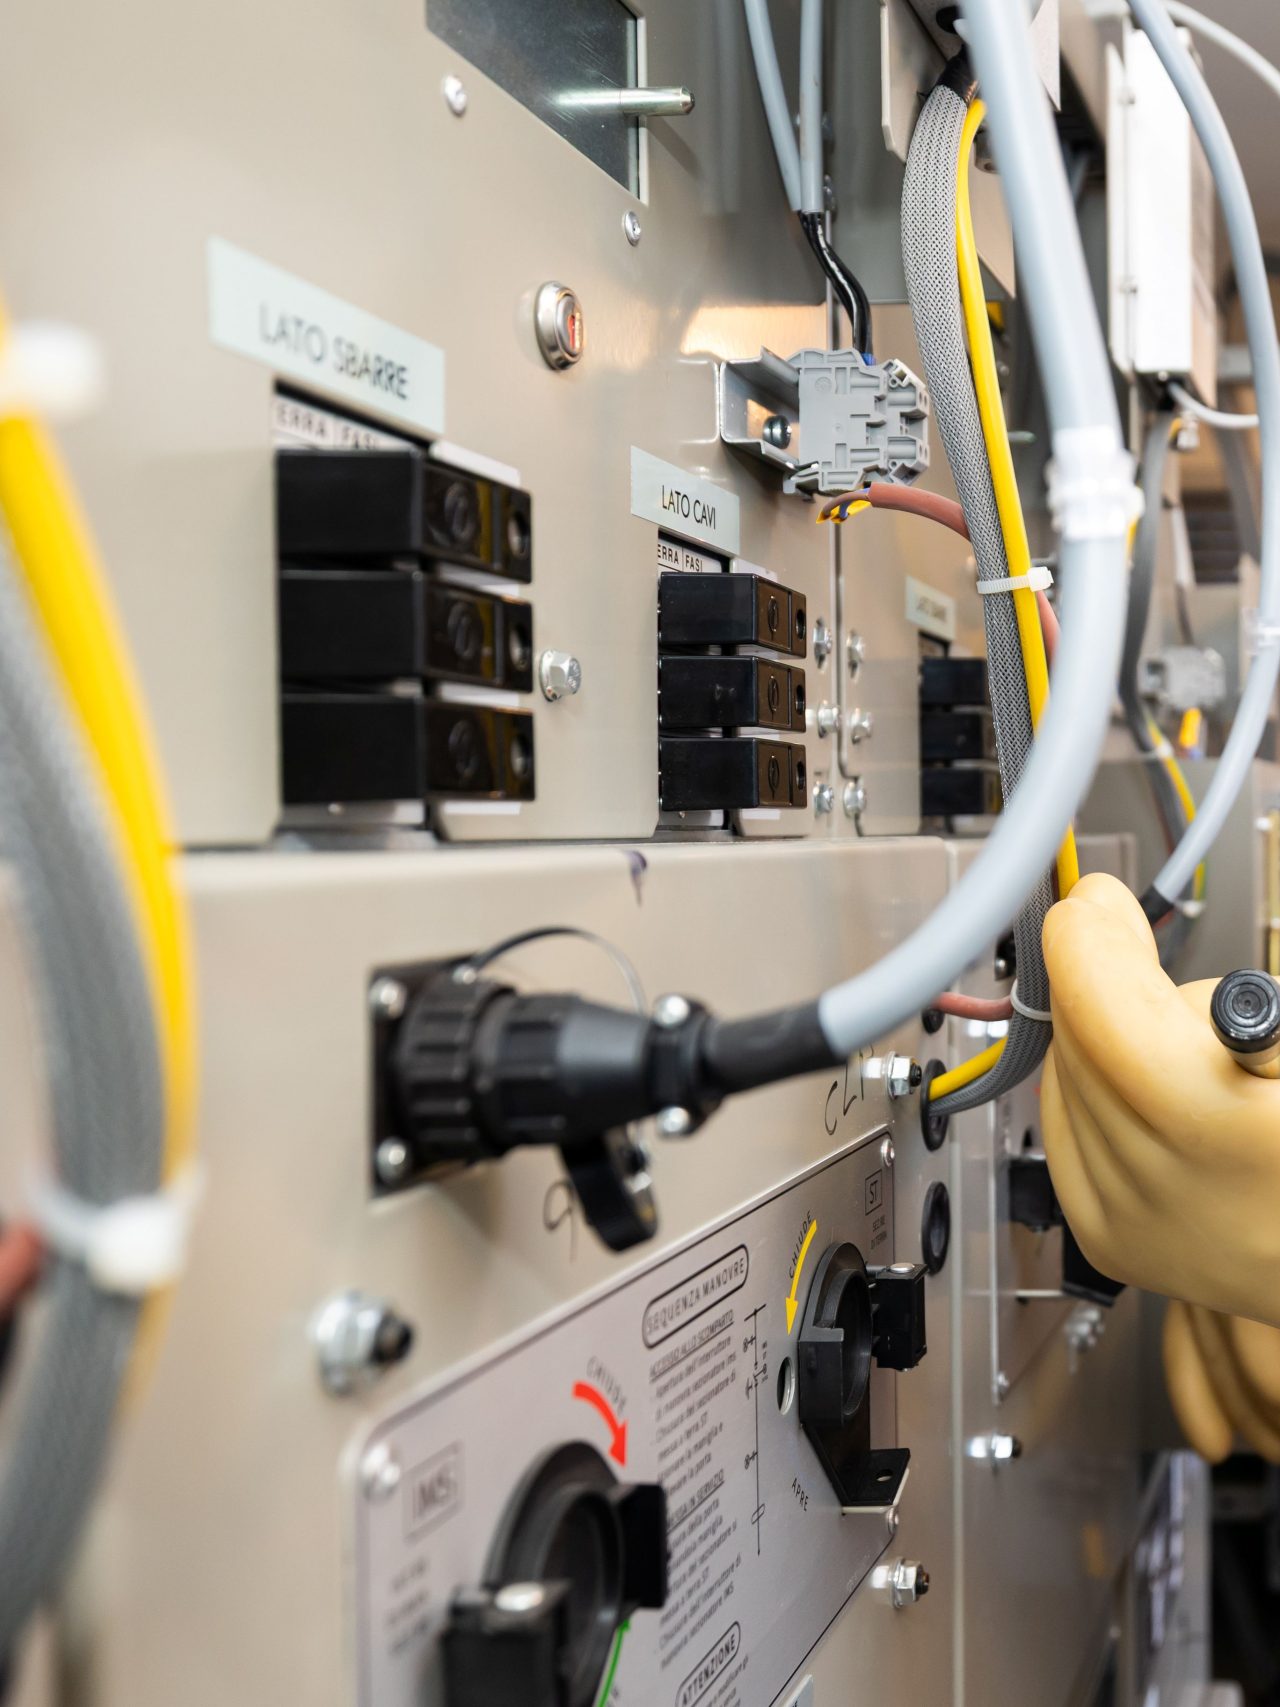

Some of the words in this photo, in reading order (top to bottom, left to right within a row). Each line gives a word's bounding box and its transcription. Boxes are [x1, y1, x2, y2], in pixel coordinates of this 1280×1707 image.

[259, 301, 327, 365] LATO
[333, 337, 408, 401] SBARRE
[662, 484, 690, 518] LATO
[693, 499, 716, 530] CAVI
[685, 554, 703, 572] FASI
[869, 1179, 879, 1205] ST
[789, 1209, 813, 1280] CHIUDE
[646, 1288, 700, 1336] SEQUENZA
[702, 1256, 745, 1299] MANOVRE
[698, 1307, 732, 1344] SCOMPARTO
[697, 1467, 723, 1501] SERVIZIO
[792, 1477, 809, 1512] APRE
[682, 1632, 736, 1707] ATTENZIONE
